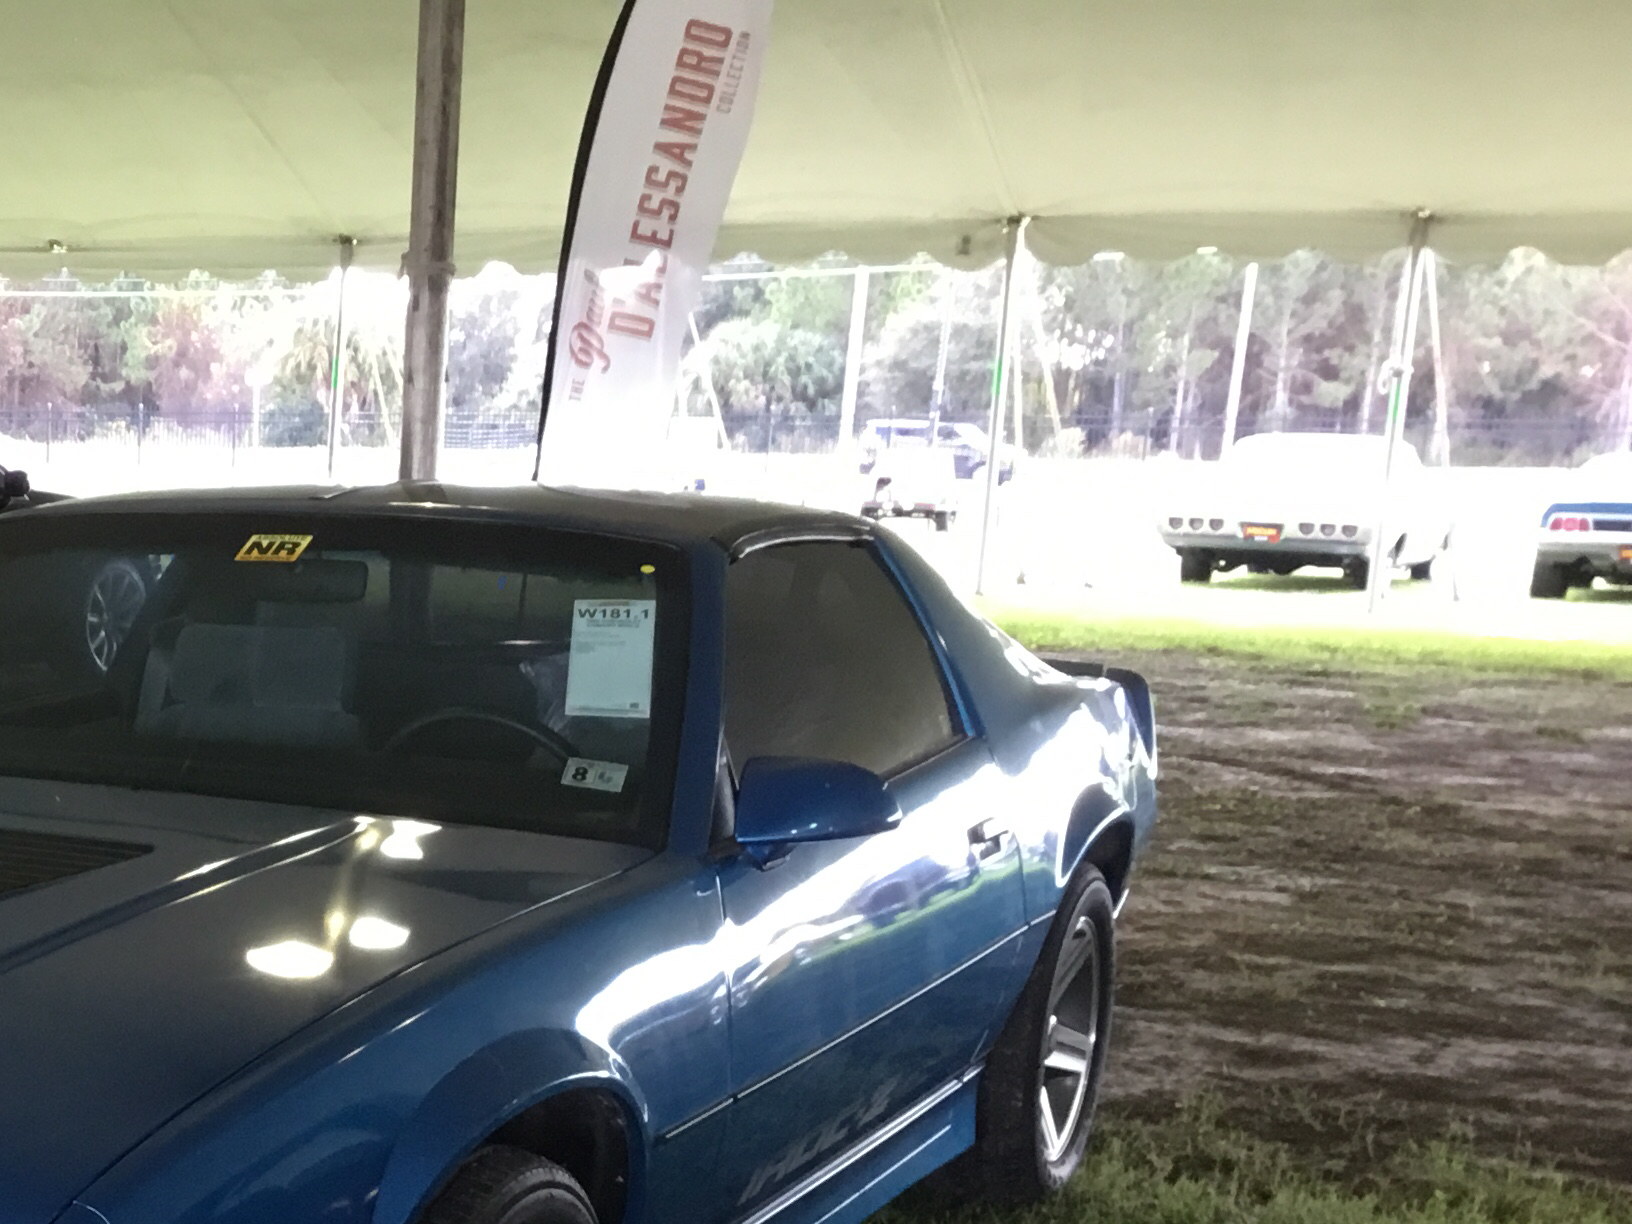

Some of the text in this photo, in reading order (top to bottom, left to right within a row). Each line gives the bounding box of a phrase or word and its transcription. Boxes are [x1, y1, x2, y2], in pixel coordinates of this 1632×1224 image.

[716, 31, 750, 114] COLLECTION
[243, 541, 302, 555] NR
[578, 608, 649, 619] W181.1
[572, 767, 588, 781] 8
